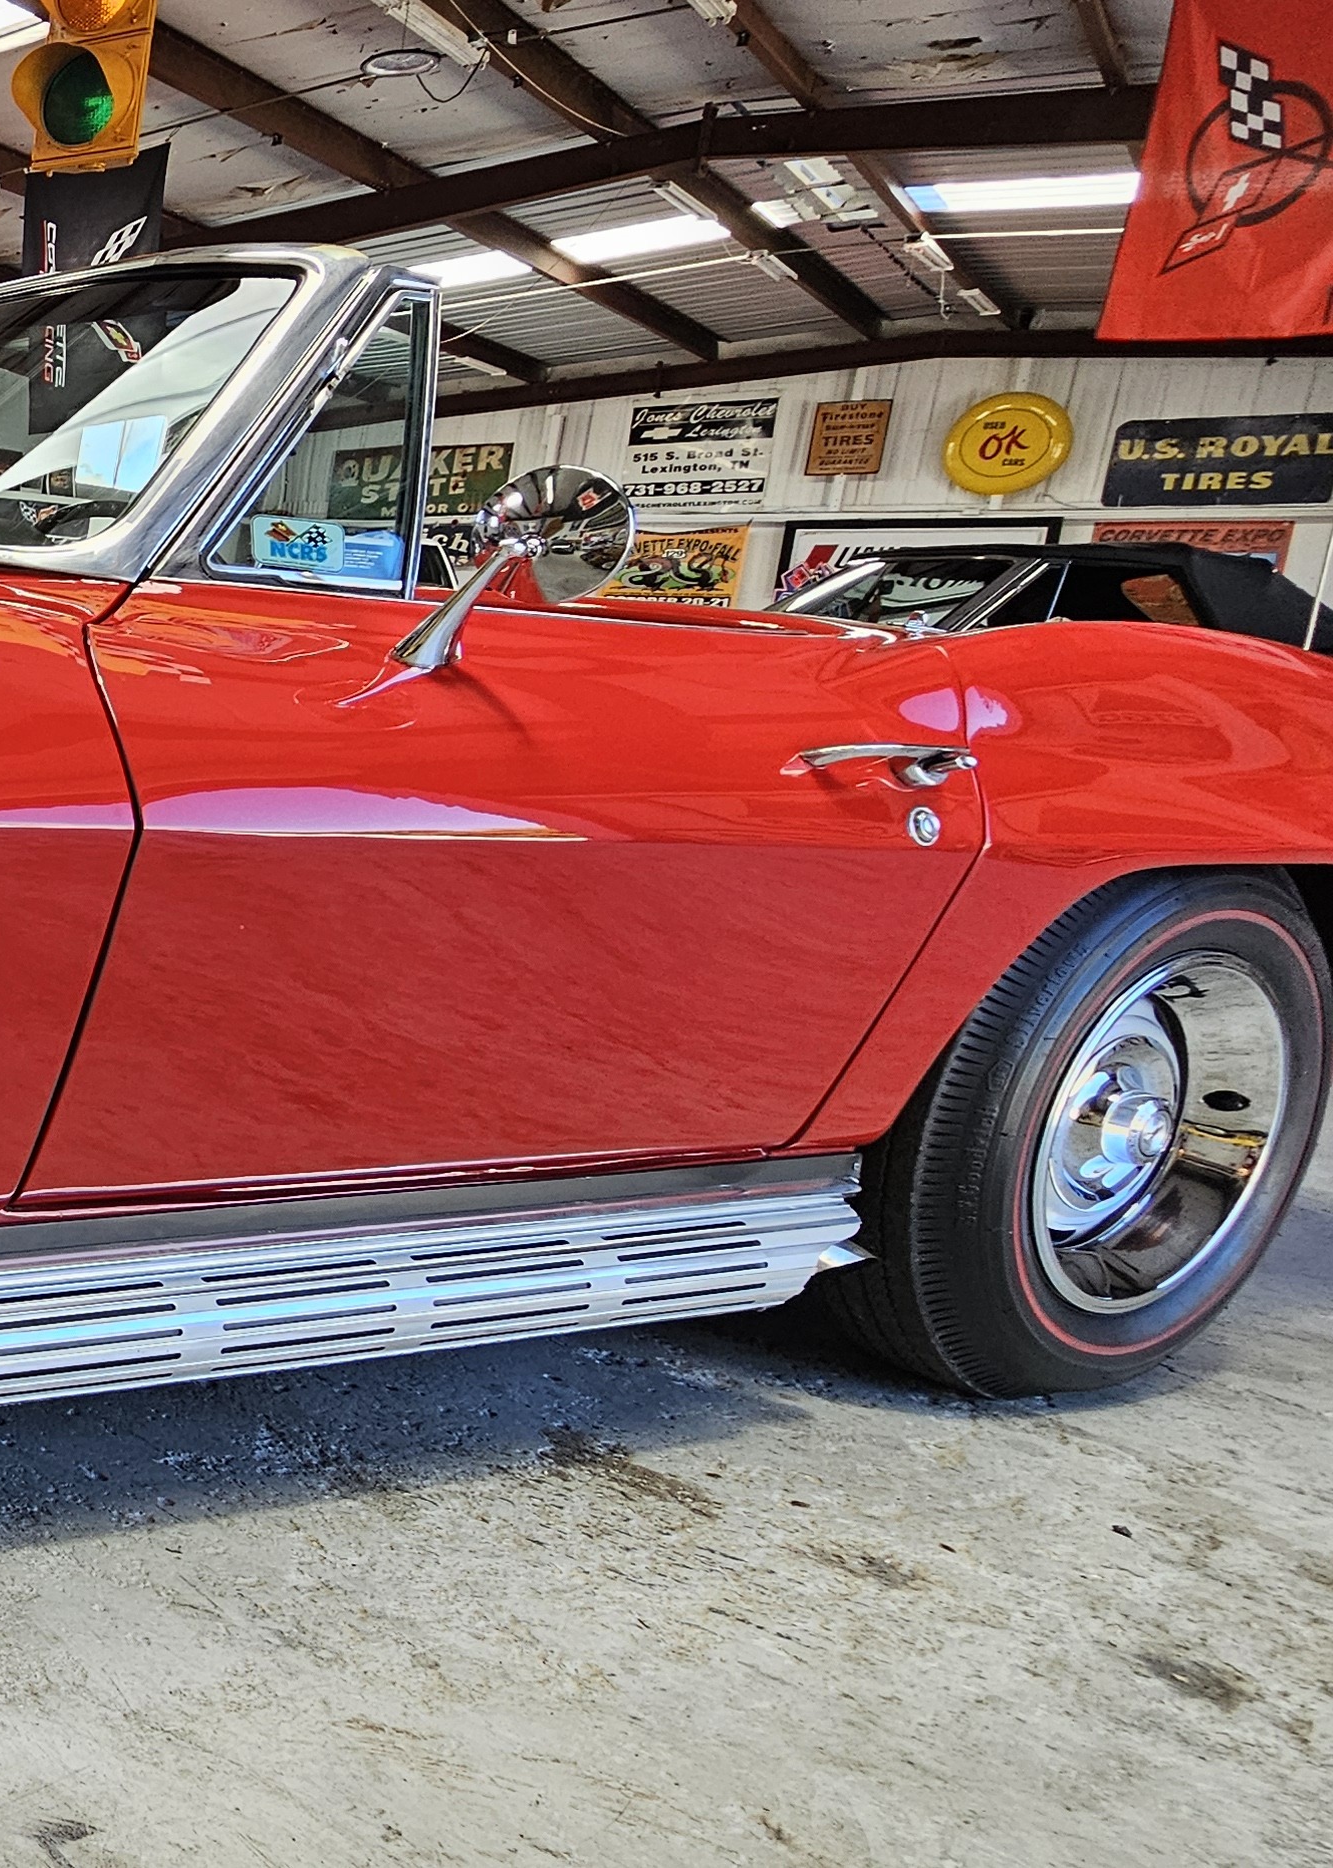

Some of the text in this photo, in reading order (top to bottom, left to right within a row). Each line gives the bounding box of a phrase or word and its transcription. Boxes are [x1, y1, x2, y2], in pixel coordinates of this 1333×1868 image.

[841, 403, 867, 411] BUY
[632, 401, 777, 429] Jones Chevrolet
[821, 411, 884, 423] Firestone
[685, 424, 762, 439] Lexington
[983, 422, 1006, 430] USED
[822, 434, 874, 446] TIRES
[979, 425, 1030, 460] OK
[1118, 433, 1333, 461] U.S. ROYAL
[633, 452, 659, 463] 515
[666, 452, 680, 461] S.
[1002, 458, 1025, 466] CARS
[641, 459, 750, 475] Lexington, TN
[624, 478, 763, 497] 731-968-2527
[1161, 471, 1275, 491] TIRES
[360, 476, 467, 504] STTE
[381, 503, 448, 517] MOR
[1099, 529, 1285, 543] CORVETTE EXPO
[269, 541, 328, 563] NCRS
[633, 538, 674, 554] VETTE
